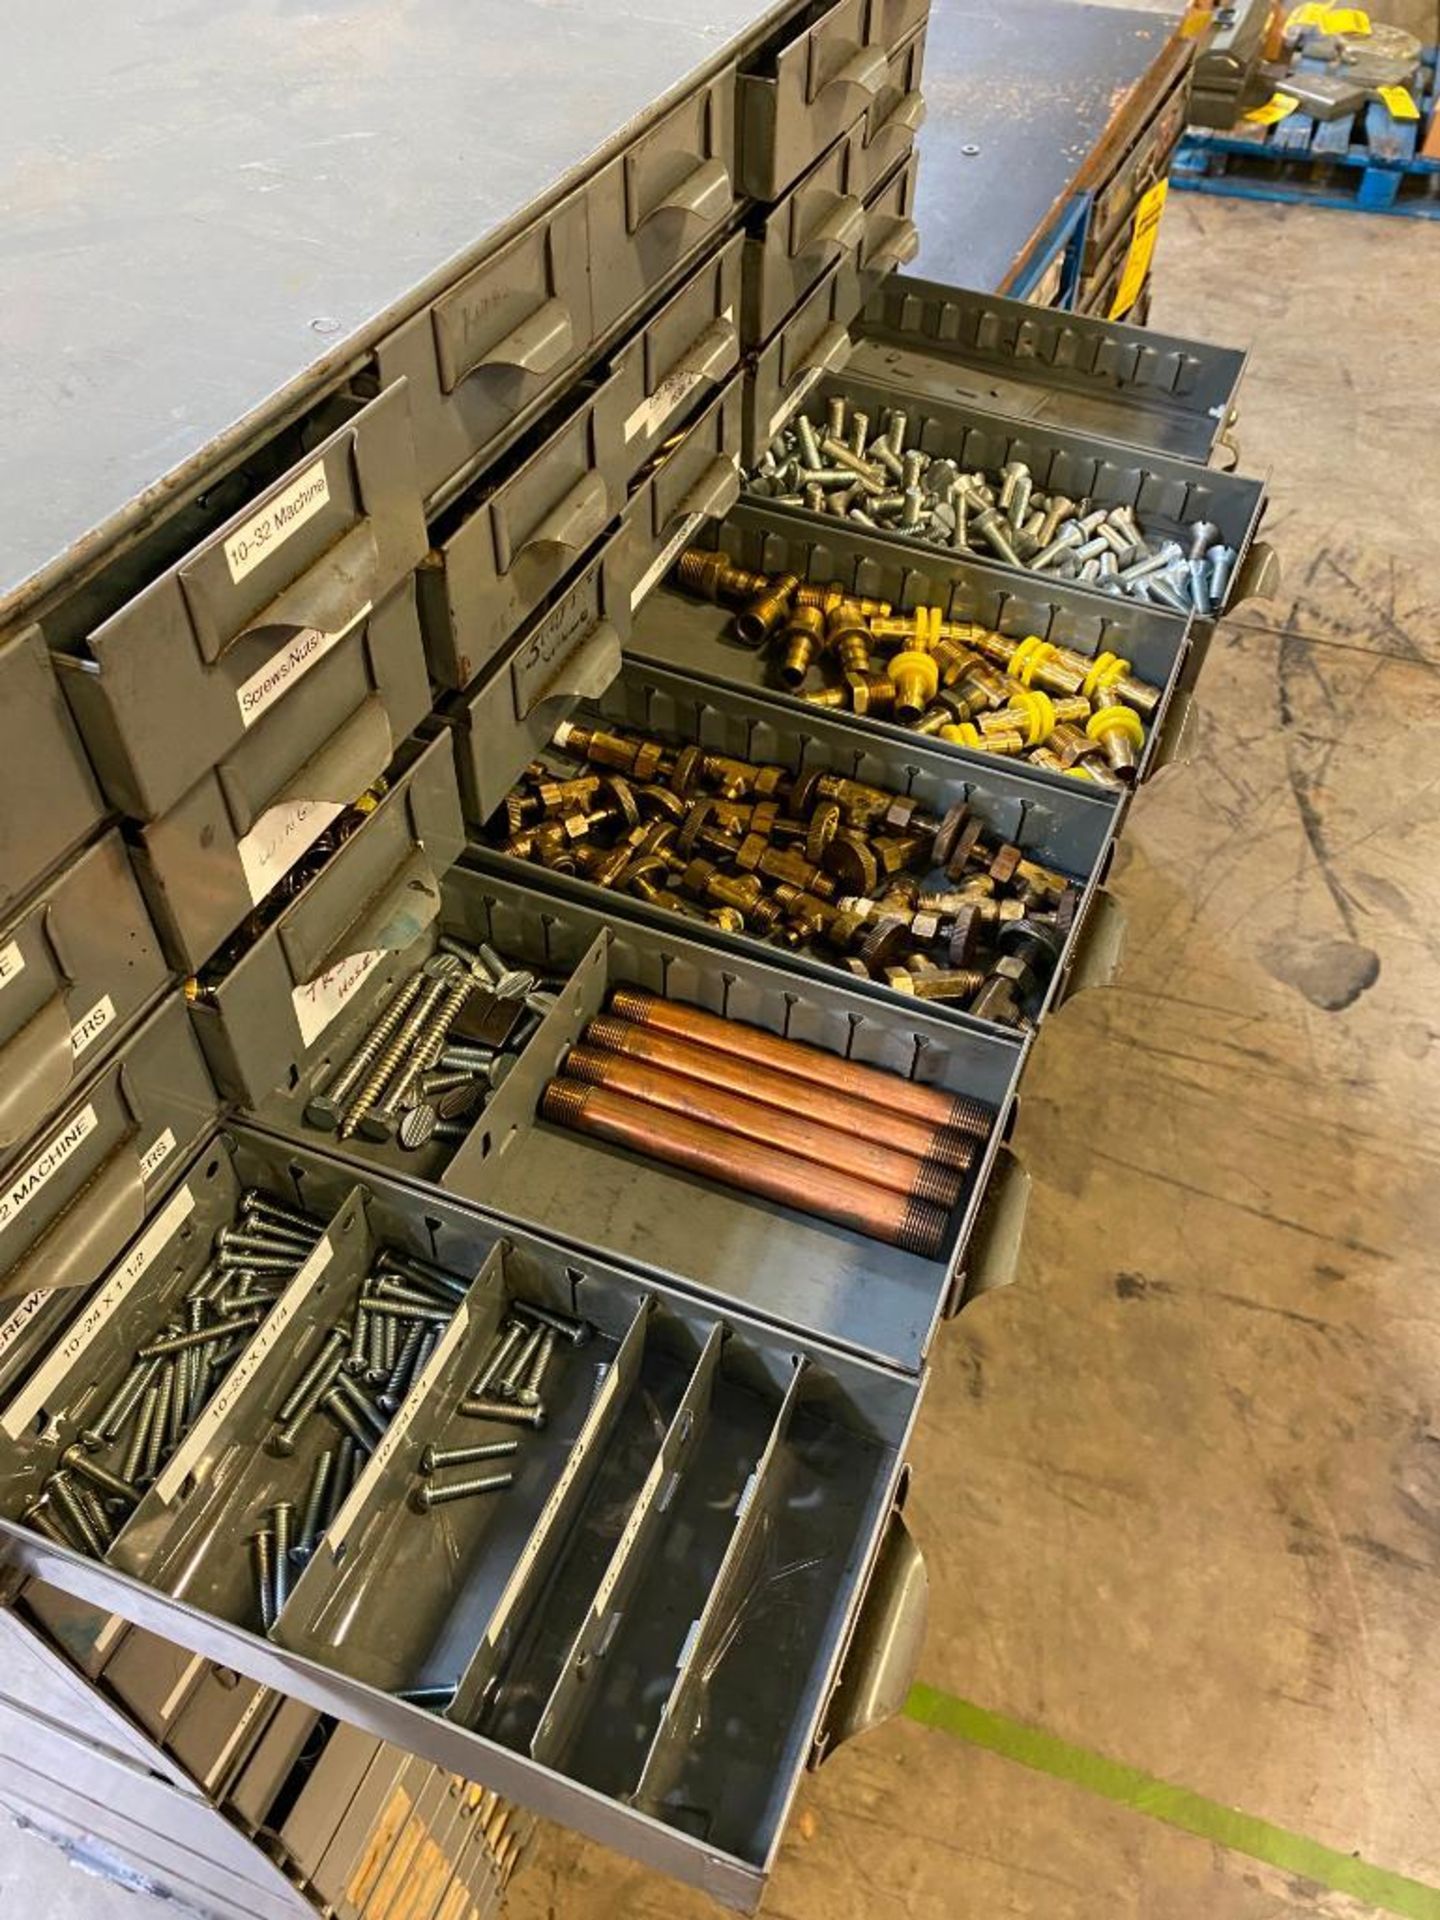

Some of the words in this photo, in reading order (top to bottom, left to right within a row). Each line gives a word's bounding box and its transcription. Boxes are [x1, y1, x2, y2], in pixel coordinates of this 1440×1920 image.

[231, 522, 272, 567] 10-32
[273, 478, 325, 531] Machine
[71, 1009, 106, 1049] ERS
[12, 1116, 89, 1205] MACHINE
[102, 1292, 114, 1308] X
